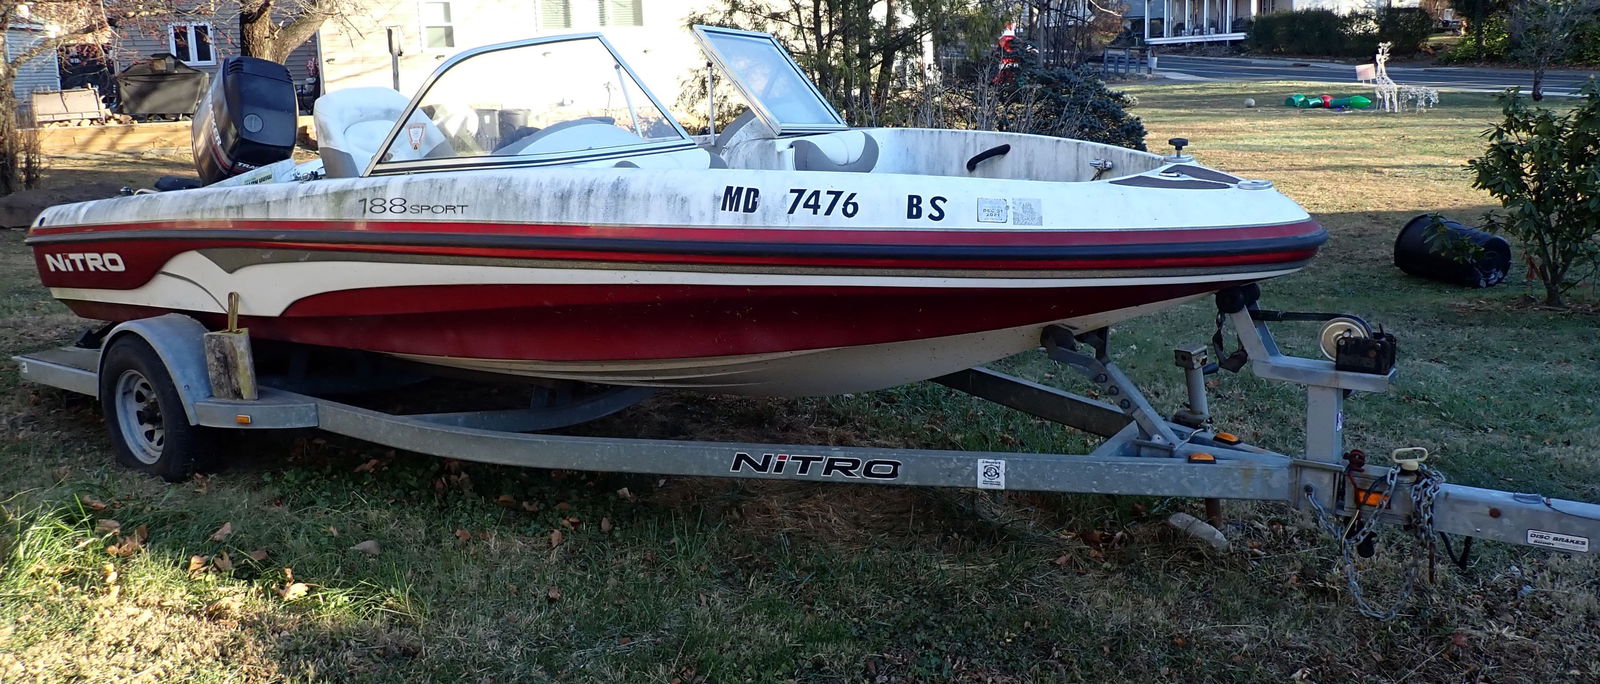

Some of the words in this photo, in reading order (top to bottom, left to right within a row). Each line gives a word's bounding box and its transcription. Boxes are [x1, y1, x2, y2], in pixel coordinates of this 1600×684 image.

[358, 197, 407, 217] 188
[409, 204, 469, 214] SPORT
[720, 185, 760, 214] MD
[787, 188, 859, 218] 7476
[906, 194, 948, 222] BS
[1552, 537, 1586, 545] BRAKES
